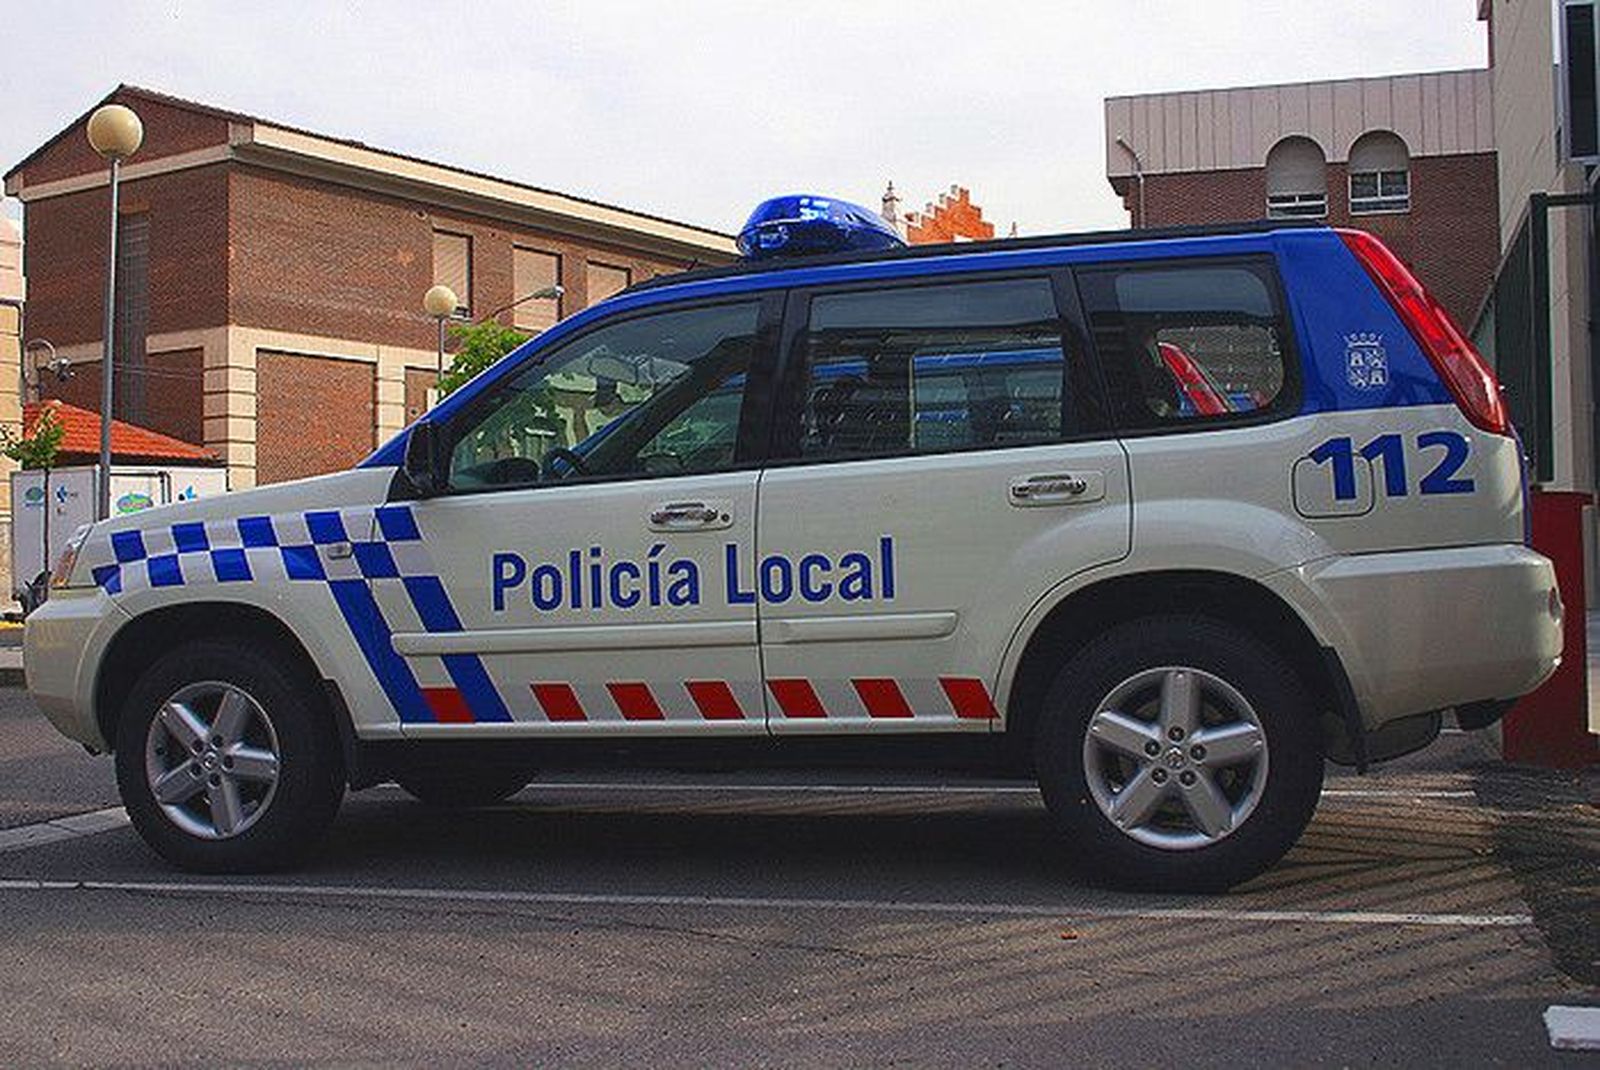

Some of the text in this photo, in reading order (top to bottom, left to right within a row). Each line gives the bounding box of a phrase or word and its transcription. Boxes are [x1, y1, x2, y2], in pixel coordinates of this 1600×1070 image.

[1309, 431, 1475, 501] 112
[492, 537, 895, 611] Policía Local
